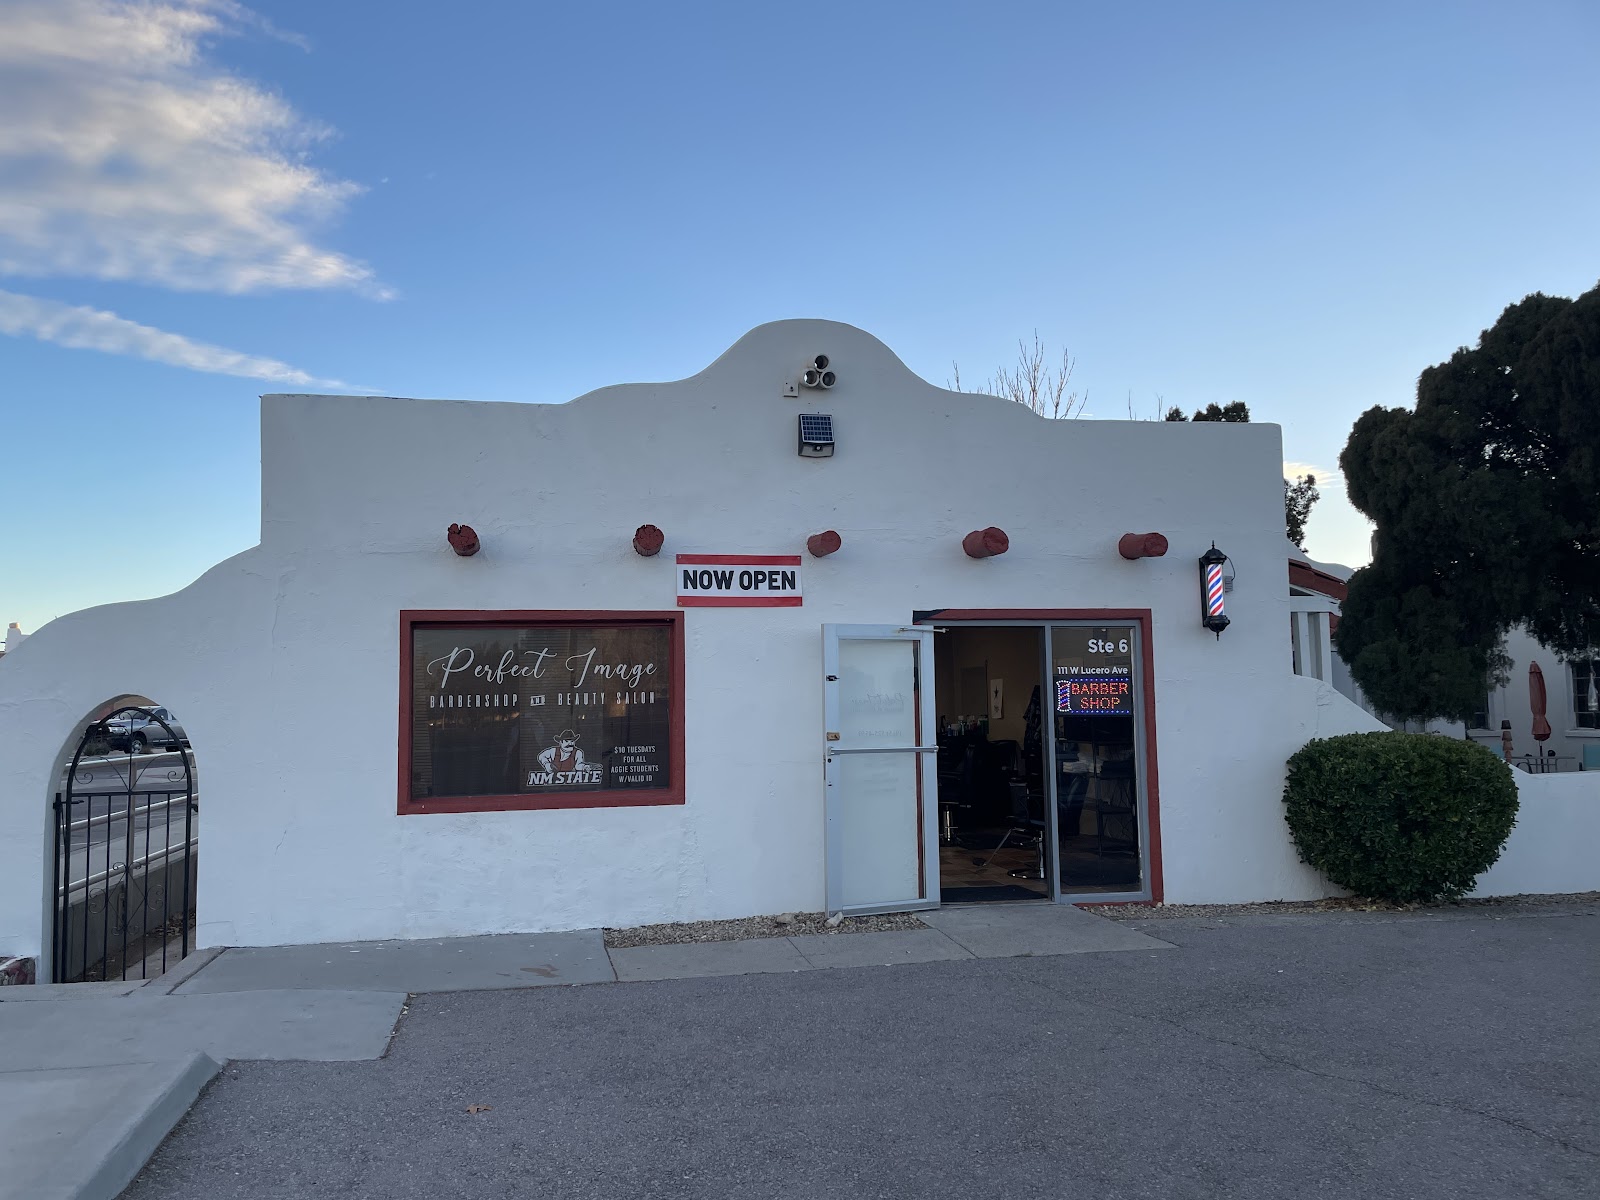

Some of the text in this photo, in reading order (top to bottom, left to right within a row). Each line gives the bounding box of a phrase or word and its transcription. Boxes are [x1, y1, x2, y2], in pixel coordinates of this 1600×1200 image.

[683, 570, 796, 590] NOW OPEN
[1088, 639, 1128, 653] Ste 6
[427, 646, 657, 689] Perfect Image
[1057, 667, 1068, 675] 111
[1112, 666, 1129, 674] Ave
[1071, 683, 1129, 695] BARBER
[430, 694, 519, 708] BARBERSHOP
[558, 692, 605, 706] BEAUTY
[616, 691, 655, 705] SALON
[1080, 697, 1120, 709] SHOP
[614, 745, 656, 754] $10 TUESDAYS
[636, 755, 647, 763] ALL
[630, 765, 659, 773] STUDENTS
[528, 771, 602, 785] NM STATE
[619, 774, 653, 783] W/VALID ID
